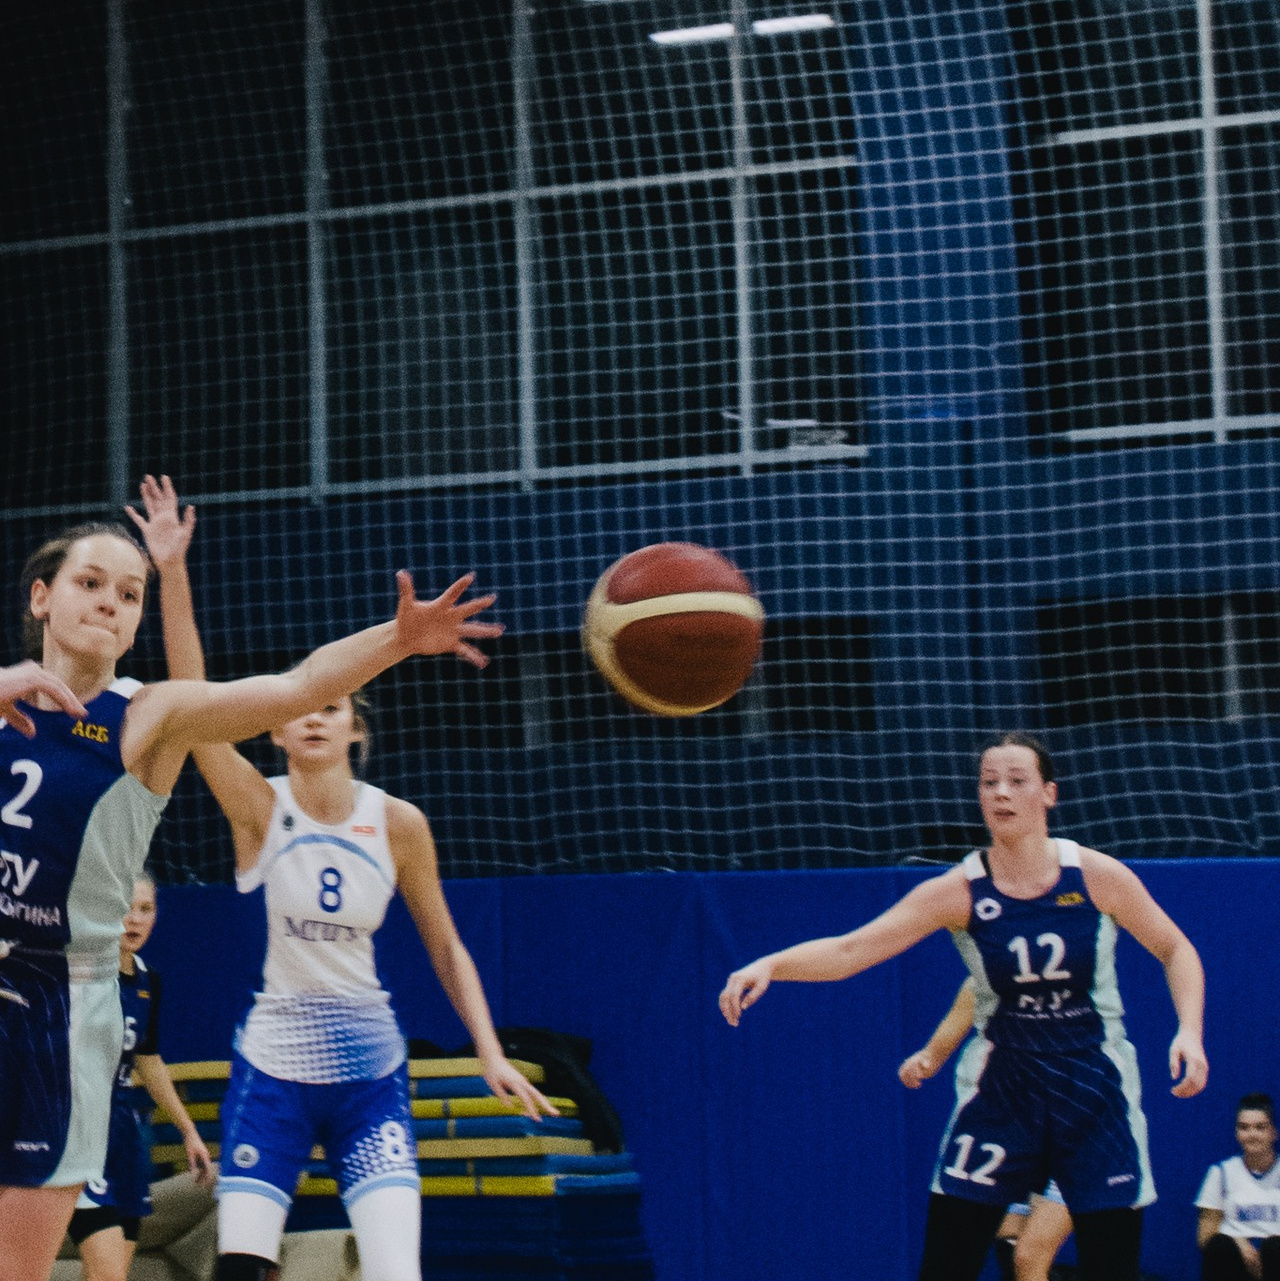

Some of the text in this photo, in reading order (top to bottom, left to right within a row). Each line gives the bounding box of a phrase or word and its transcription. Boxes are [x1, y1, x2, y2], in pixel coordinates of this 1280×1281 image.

[72, 719, 109, 744] АСБ
[0, 758, 43, 829] 2
[318, 867, 343, 913] 8
[1007, 932, 1072, 984] 12
[379, 1120, 409, 1163] 8
[944, 1133, 1007, 1187] 12
